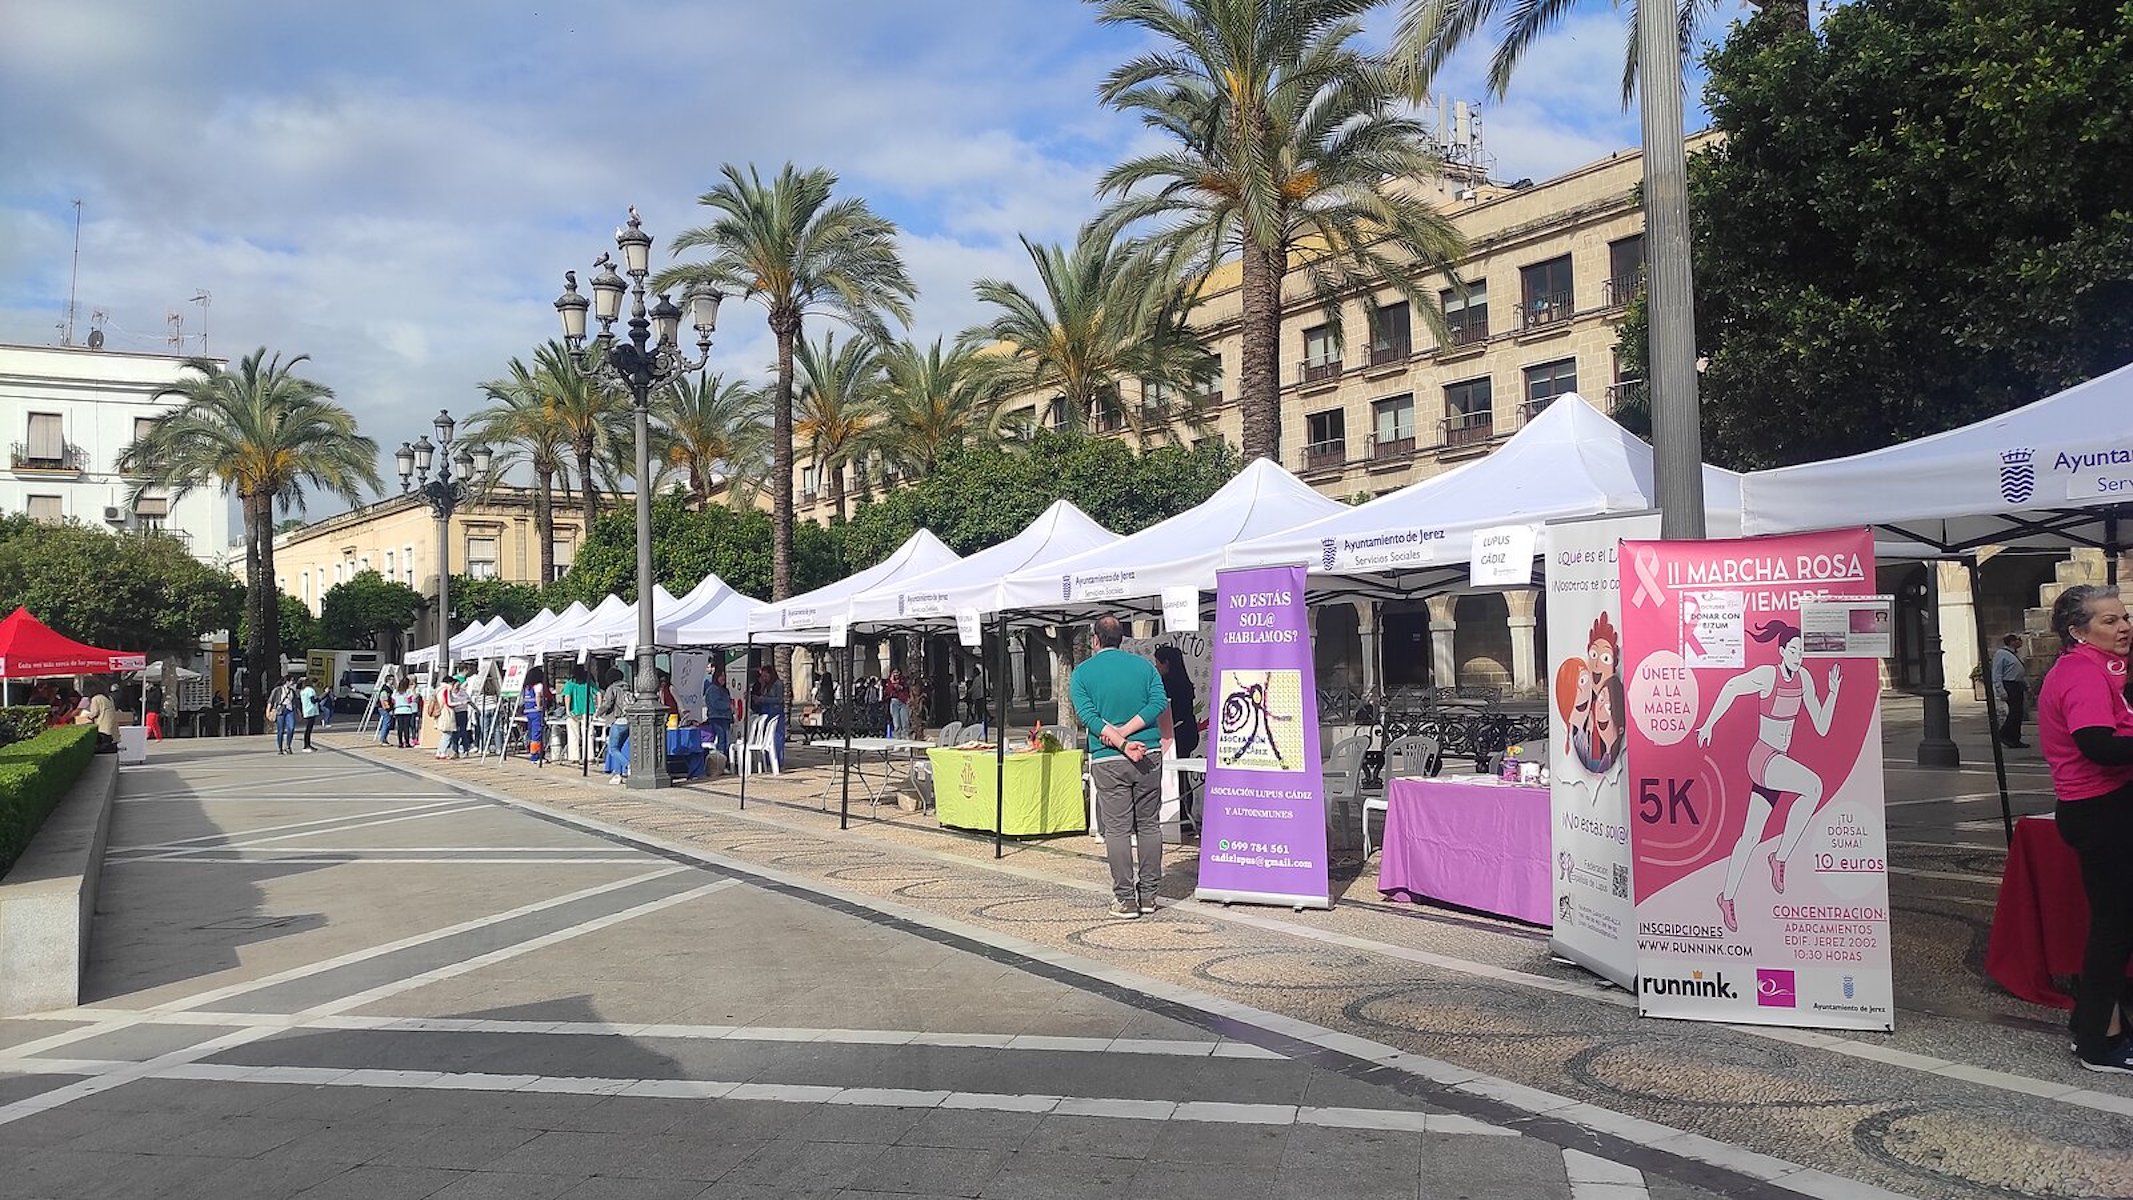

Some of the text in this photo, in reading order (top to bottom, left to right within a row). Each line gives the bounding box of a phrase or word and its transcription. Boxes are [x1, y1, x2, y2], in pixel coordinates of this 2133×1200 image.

[2054, 449, 2133, 474] Ayunta
[1344, 529, 1445, 551] Ayuntamiento de Jerez
[1484, 536, 1510, 547] LUPUS
[1355, 550, 1421, 566] Servicios Sociales
[1558, 548, 1582, 566] ¿Qué
[1585, 552, 1595, 562] es
[1599, 550, 1605, 562] el
[1668, 553, 1864, 585] II MARCHA ROSA
[1076, 571, 1135, 587] Ayuntamiento de Jerez
[1591, 581, 1598, 590] te
[1601, 580, 1607, 589] lo
[1230, 589, 1291, 608] NO ESTÁS
[1240, 612, 1276, 627] SOL@
[1223, 630, 1298, 644] ¿HABLAMOS?
[1642, 666, 1686, 680] ÚNETE
[1653, 686, 1681, 697] A LA
[1644, 701, 1690, 715] MAREA
[1650, 719, 1686, 732] ROSA
[1210, 786, 1312, 800] ASOCIACIÓN LUPUS CÁDIZ
[1639, 778, 1700, 825] 5K
[1224, 807, 1294, 819] Y AUTOINMUNES
[1837, 814, 1853, 826] ¡TU
[1562, 811, 1578, 829] ¡No
[1581, 818, 1603, 836] estás
[1827, 826, 1868, 837] DORSAL
[1231, 841, 1290, 854] 699 784 561
[1832, 838, 1862, 848] SUMA!
[1815, 854, 1884, 870] 10 euros
[1639, 922, 1723, 937] INSCRIPCIONES
[1785, 923, 1872, 935] APARCAMIENTOS
[1637, 940, 1753, 956] WWW.RUNNINK.COM
[1785, 936, 1877, 948] EDIF. JEREZ 2002
[1794, 950, 1862, 961] 10:30 HORAS
[1643, 972, 1738, 998] runnink.
[1813, 1002, 1886, 1014] Ayuntamiento de Jerez
